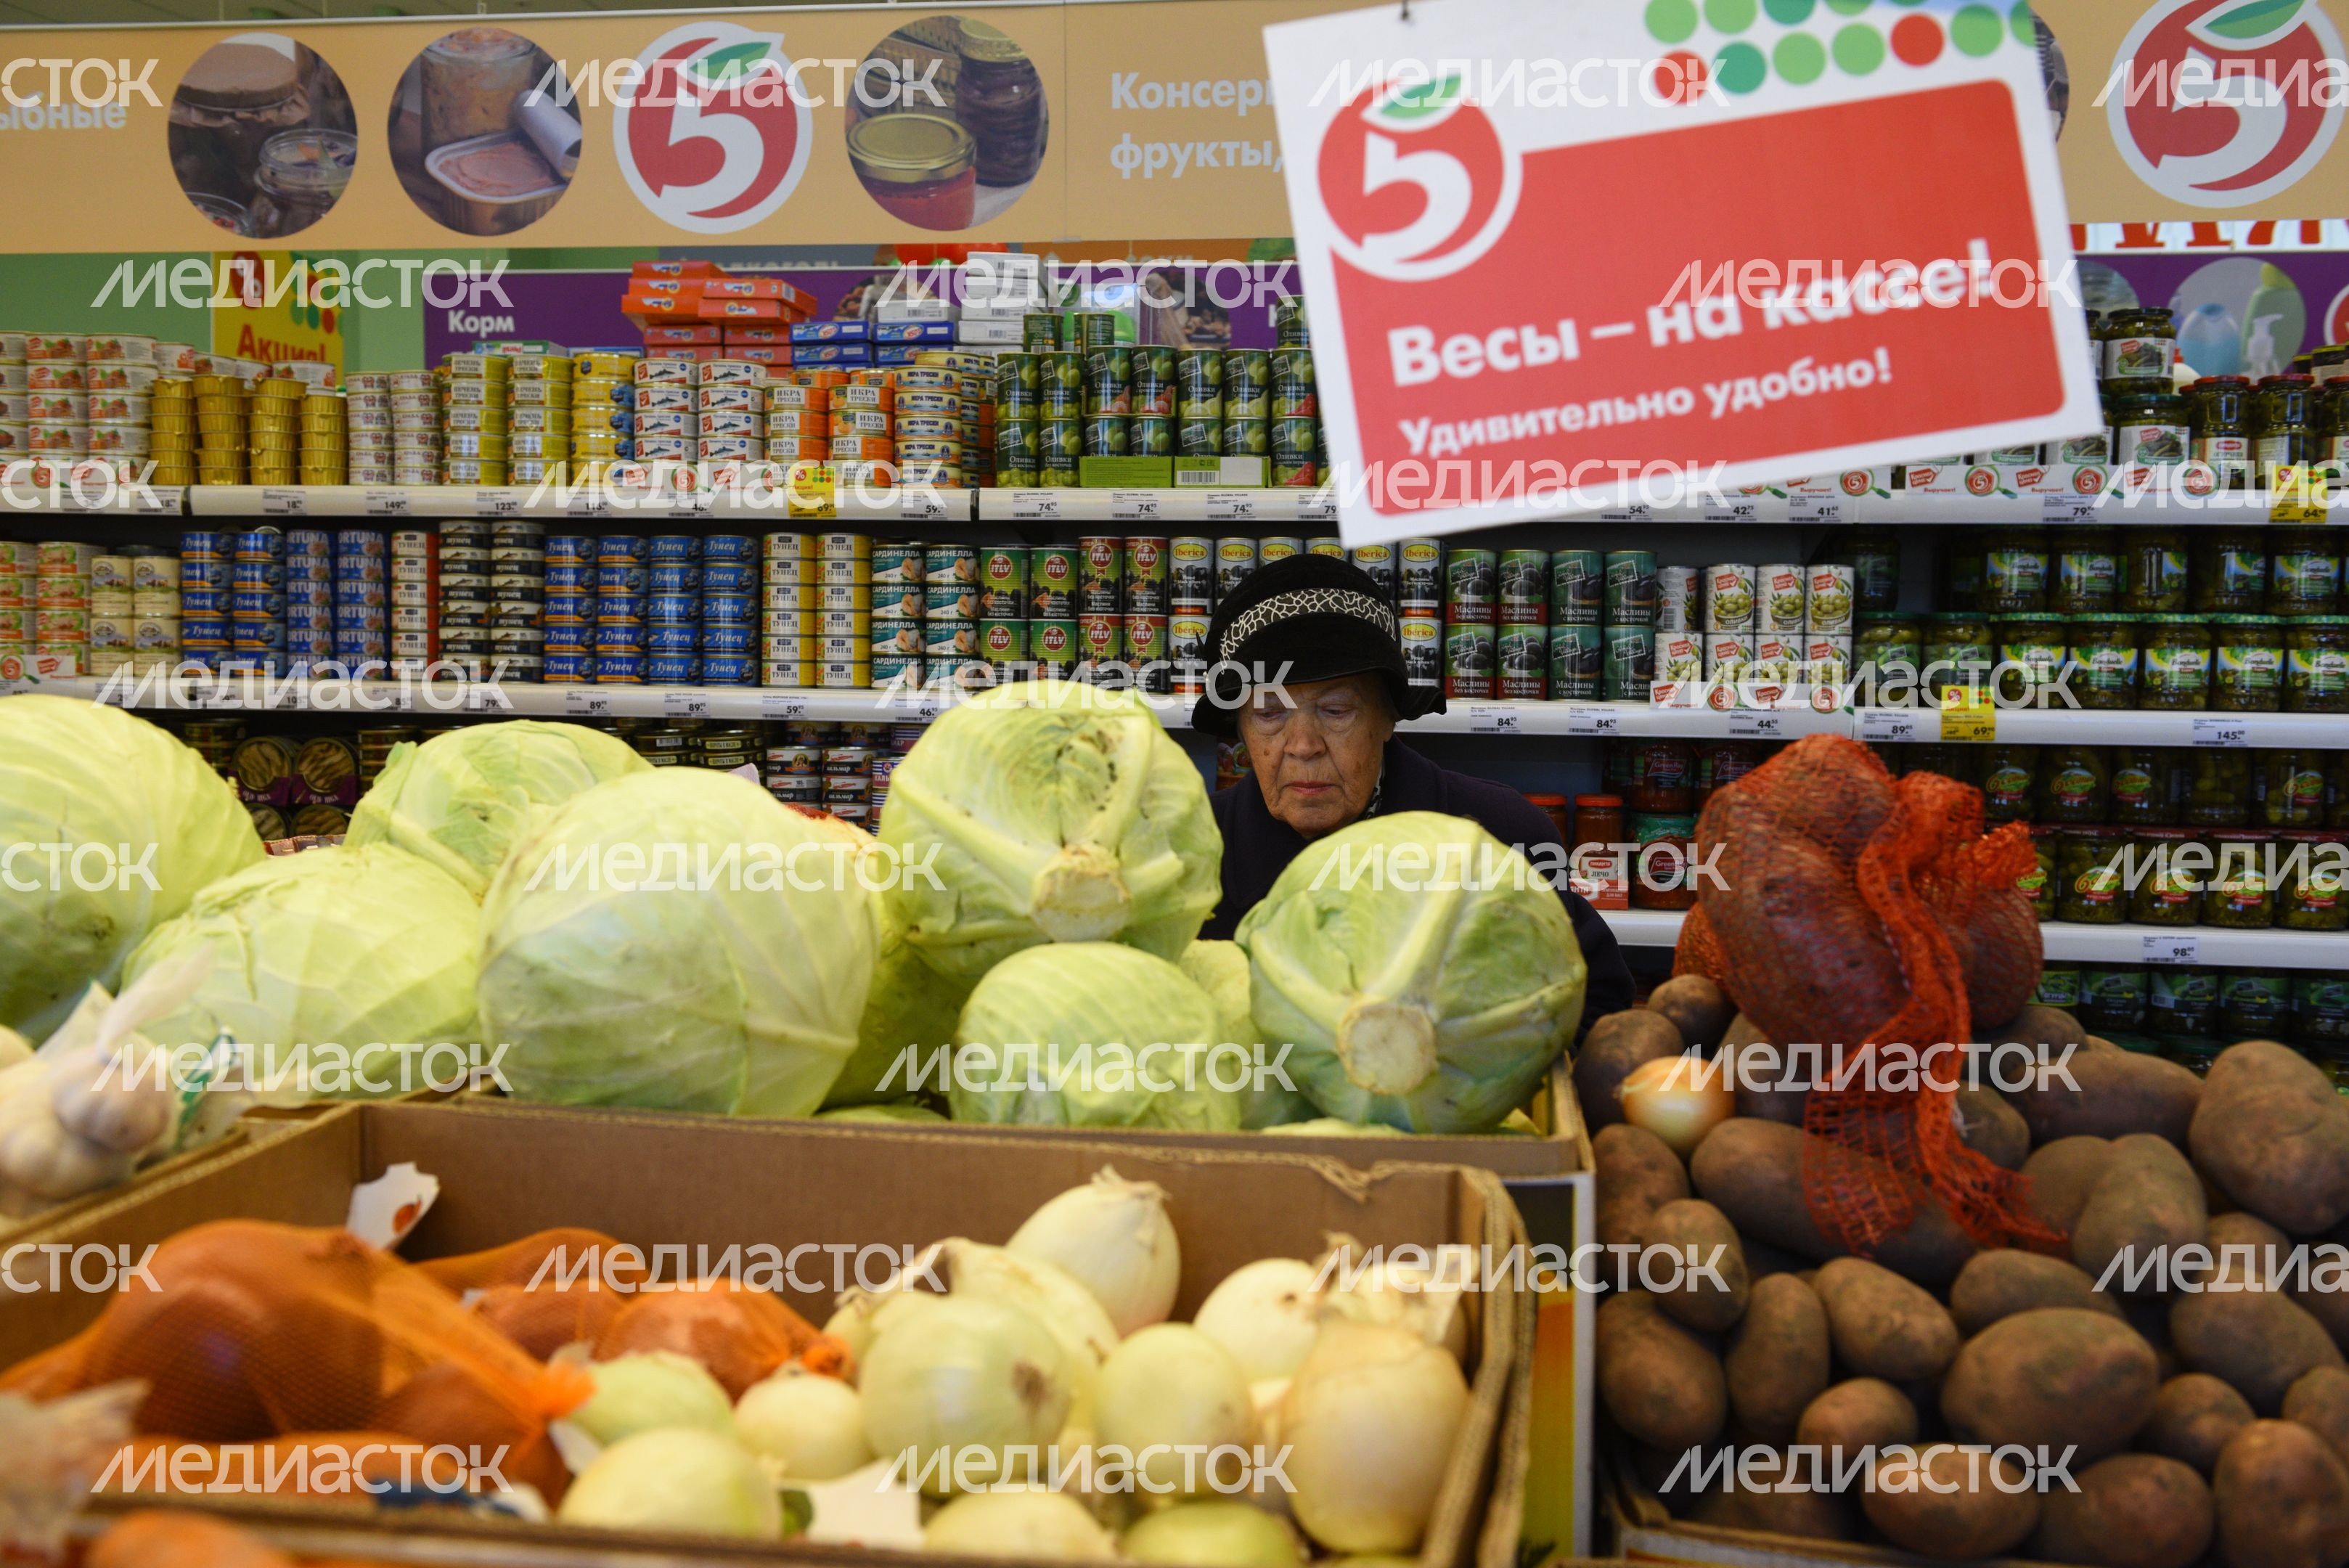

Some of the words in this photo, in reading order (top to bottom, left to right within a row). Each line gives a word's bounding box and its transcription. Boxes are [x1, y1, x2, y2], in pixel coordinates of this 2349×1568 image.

[447, 309, 515, 338] Корм
[1386, 319, 1579, 387] Весы
[1646, 294, 1742, 347] на
[1400, 387, 1694, 457] Удивительно
[1704, 347, 1892, 419] удобно!
[1039, 502, 1057, 511] 74.95
[1138, 504, 1156, 513] 74.95
[1233, 504, 1252, 513] 74.95
[1612, 608, 1651, 616] Маслины
[550, 632, 577, 642] Тунец
[605, 632, 632, 642] Тунец
[663, 632, 690, 642] Тунец
[714, 632, 743, 643] Тунец
[605, 661, 632, 672] Тунец
[657, 662, 684, 672] Тунец
[1503, 679, 1540, 688] Маслины
[1498, 717, 1516, 726] 84.95
[1596, 719, 1616, 728] 84.95
